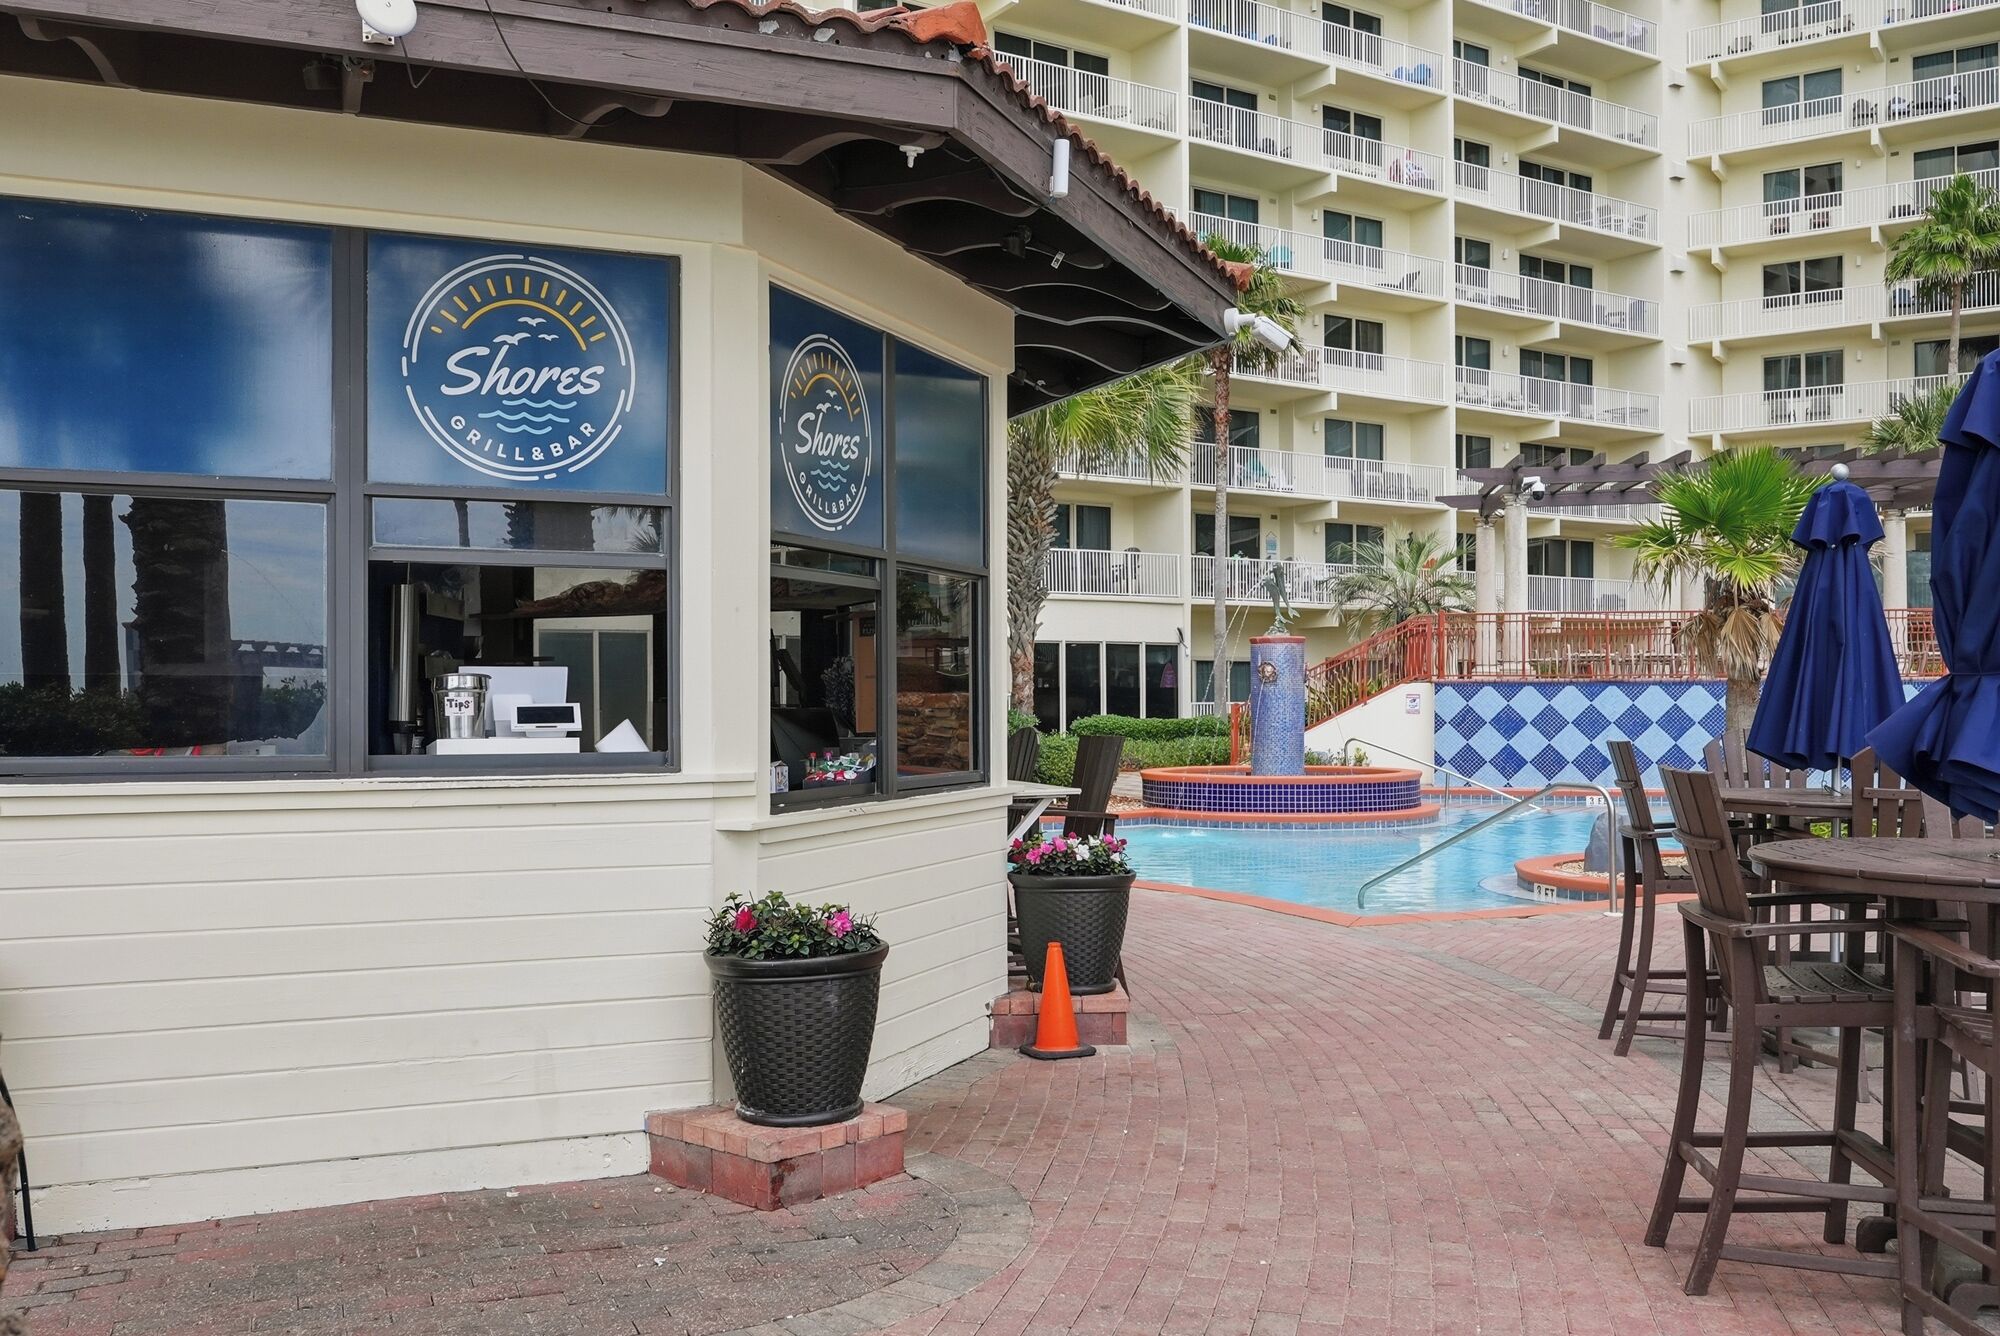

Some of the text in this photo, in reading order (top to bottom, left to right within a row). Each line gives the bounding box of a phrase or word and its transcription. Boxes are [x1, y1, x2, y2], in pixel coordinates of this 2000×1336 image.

[440, 344, 605, 396] Shores
[795, 411, 861, 460] Shores
[1544, 887, 1555, 898] FT
